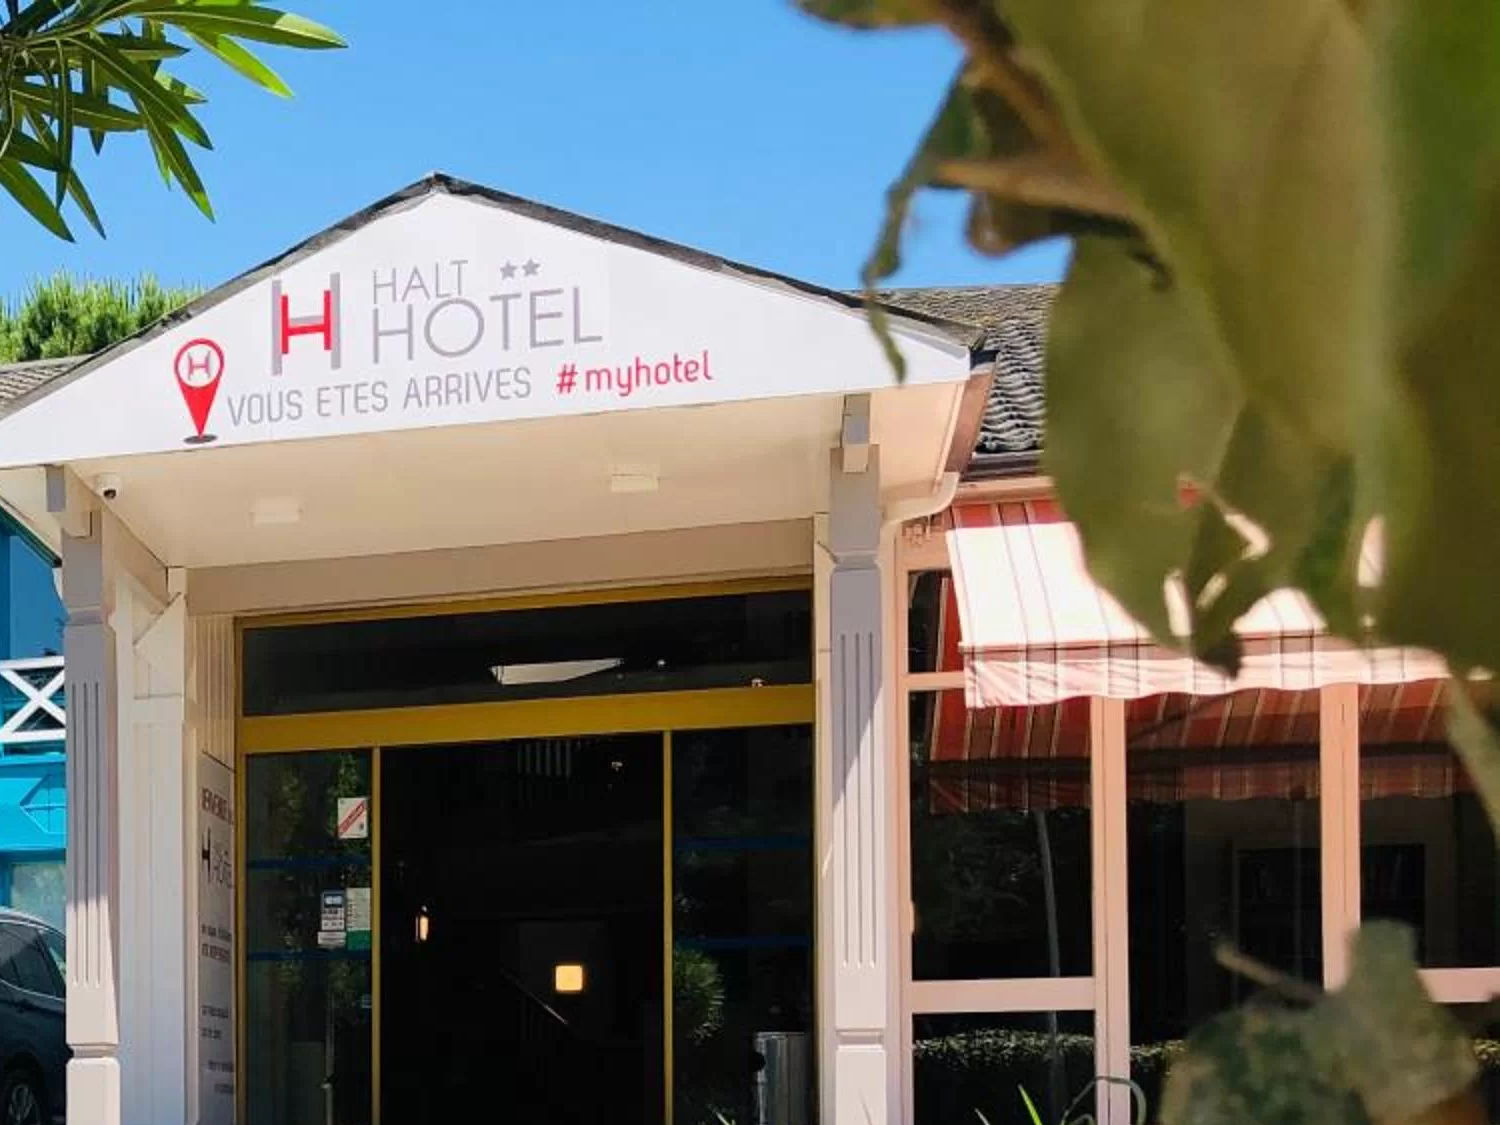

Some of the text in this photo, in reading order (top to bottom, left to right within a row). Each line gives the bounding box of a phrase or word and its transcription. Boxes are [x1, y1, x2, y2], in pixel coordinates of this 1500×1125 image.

[372, 259, 469, 305] HALT
[271, 272, 341, 376] H
[372, 286, 603, 364] HOTEL
[227, 349, 713, 427] VOUS ETES ARRIVES #myhotel
